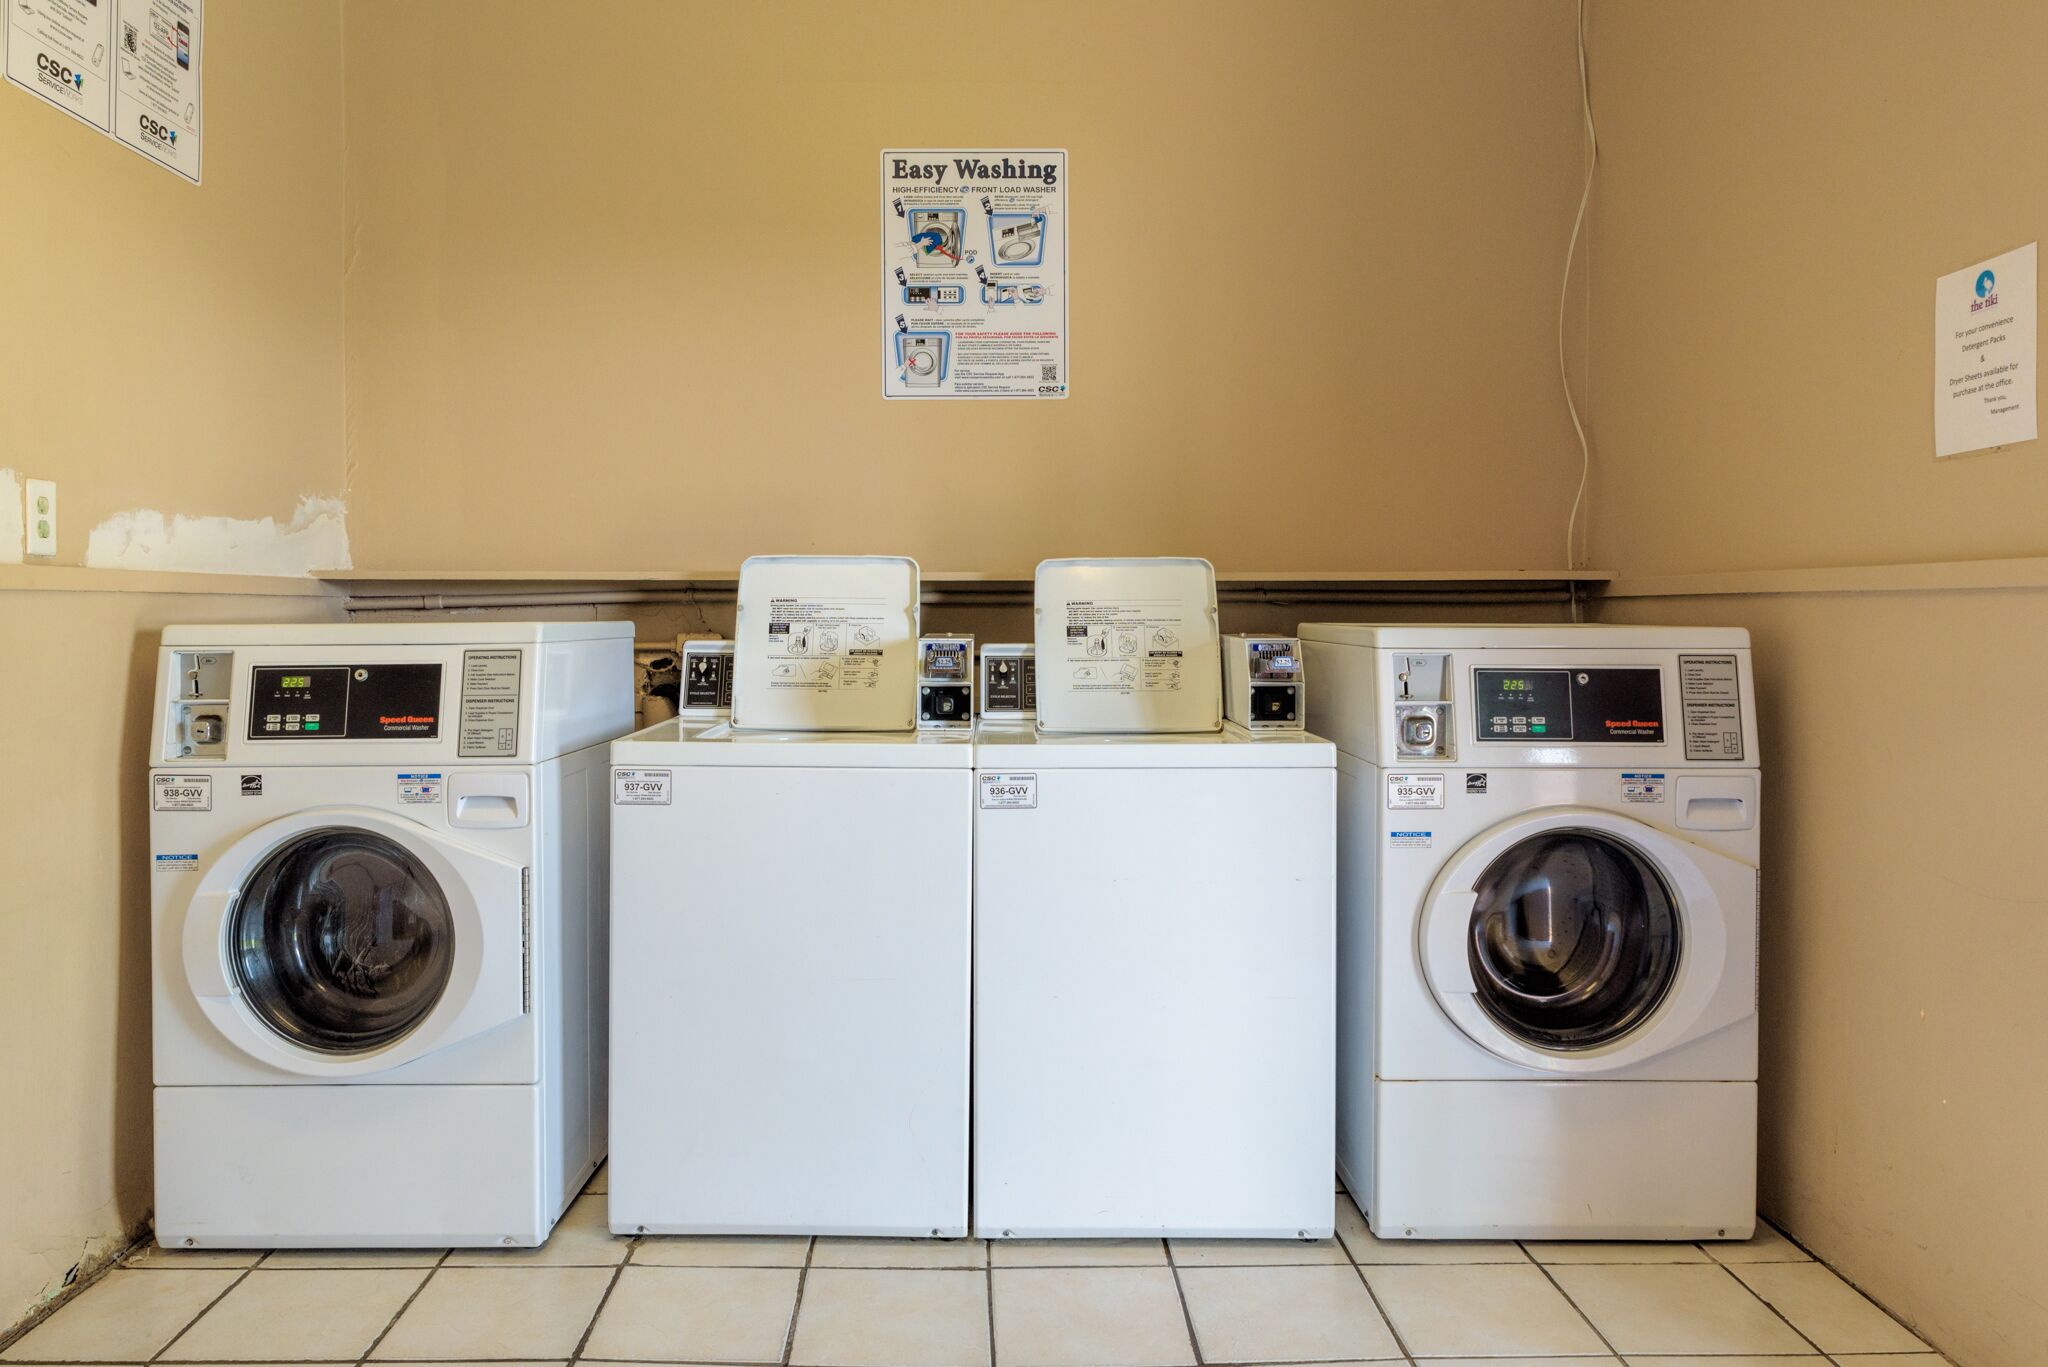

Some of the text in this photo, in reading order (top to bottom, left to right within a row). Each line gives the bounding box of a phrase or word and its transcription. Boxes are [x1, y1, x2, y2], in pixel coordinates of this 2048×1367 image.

[37, 53, 72, 84] CSC
[139, 114, 168, 141] CSC
[892, 158, 1057, 185] Easy Washing
[1970, 294, 1998, 312] the tiki
[1955, 316, 2014, 339] For your convenience
[1962, 334, 2006, 353] Detergent Packs
[1980, 354, 1985, 363] &
[1949, 362, 2019, 386] Dryer Sheets available for
[1953, 385, 1977, 399] purchase
[1978, 384, 1984, 392] at
[1985, 382, 1995, 390] the
[1984, 396, 1997, 404] Thank
[1990, 404, 2020, 415] Management
[282, 677, 304, 688] 225
[1503, 680, 1524, 690] 225
[380, 716, 407, 724] Speed
[1605, 720, 1632, 728] Speed
[624, 783, 663, 791] 937-GVV
[990, 787, 1028, 795] 936-GVV
[1397, 787, 1436, 796] 935-GVV
[163, 789, 203, 797] 938-GVV
